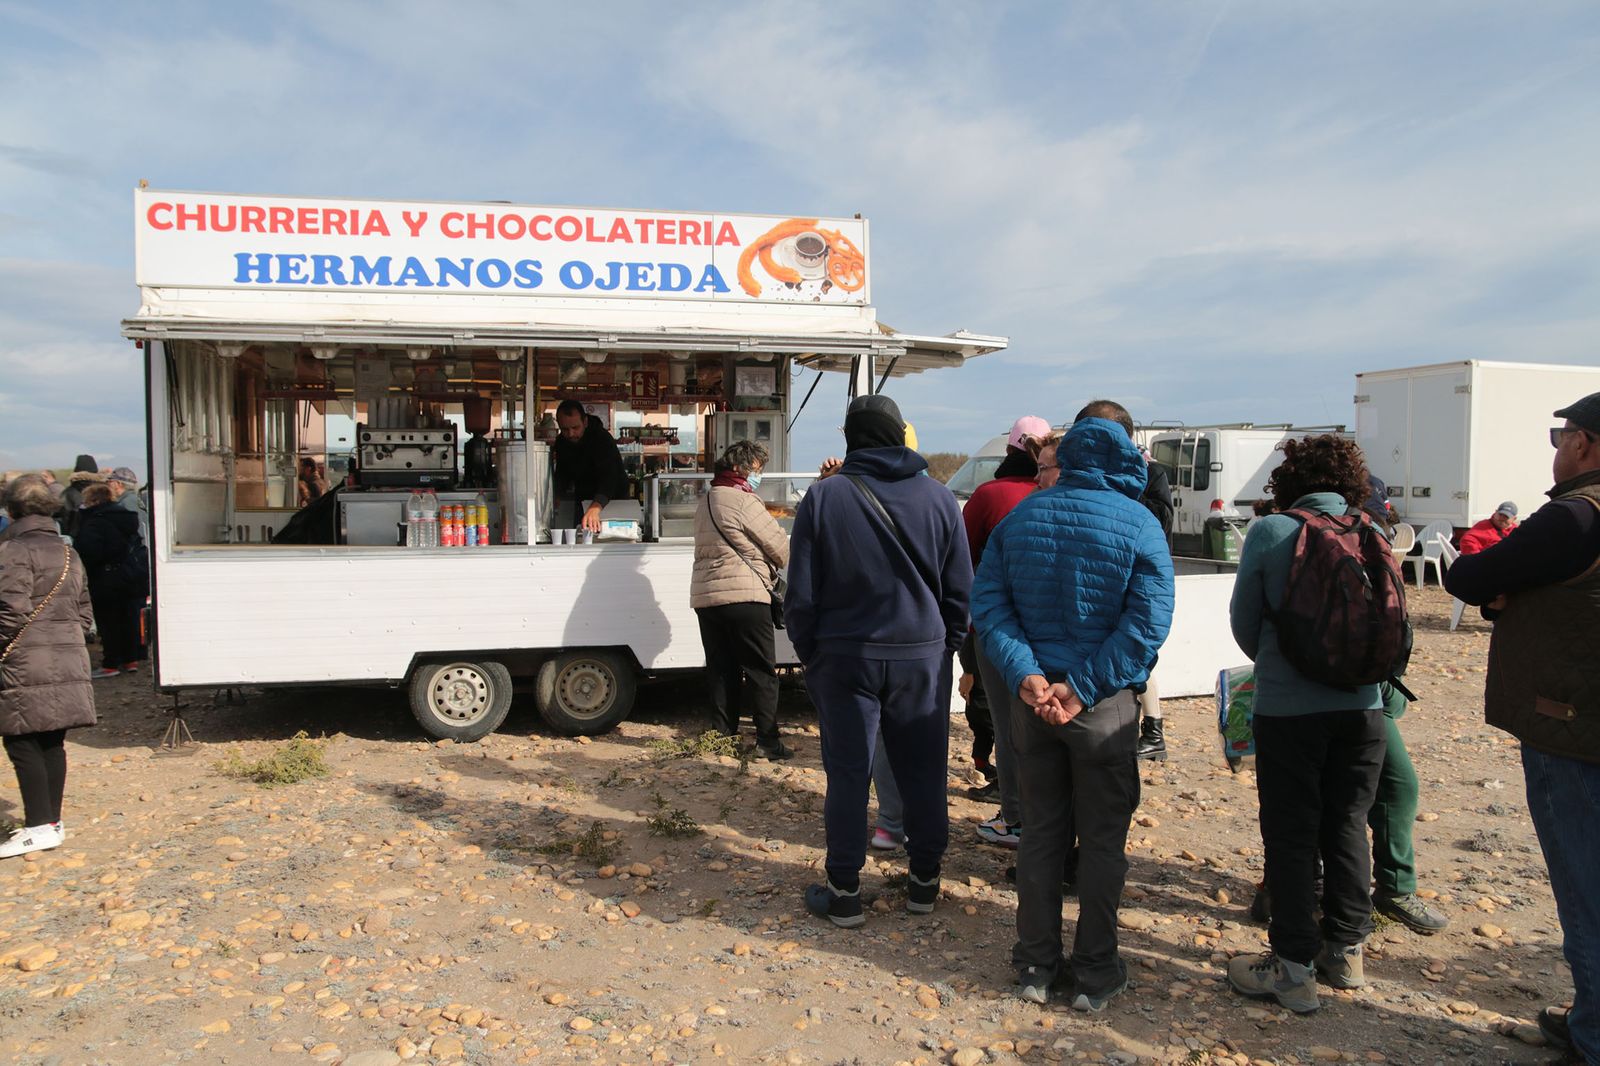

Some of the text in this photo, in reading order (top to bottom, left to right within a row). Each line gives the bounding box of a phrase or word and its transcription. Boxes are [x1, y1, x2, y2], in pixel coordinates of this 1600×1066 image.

[146, 201, 741, 247] CHURRERIA Y CHOCOLATERIA
[234, 252, 731, 295] HERMANOS OJEDA
